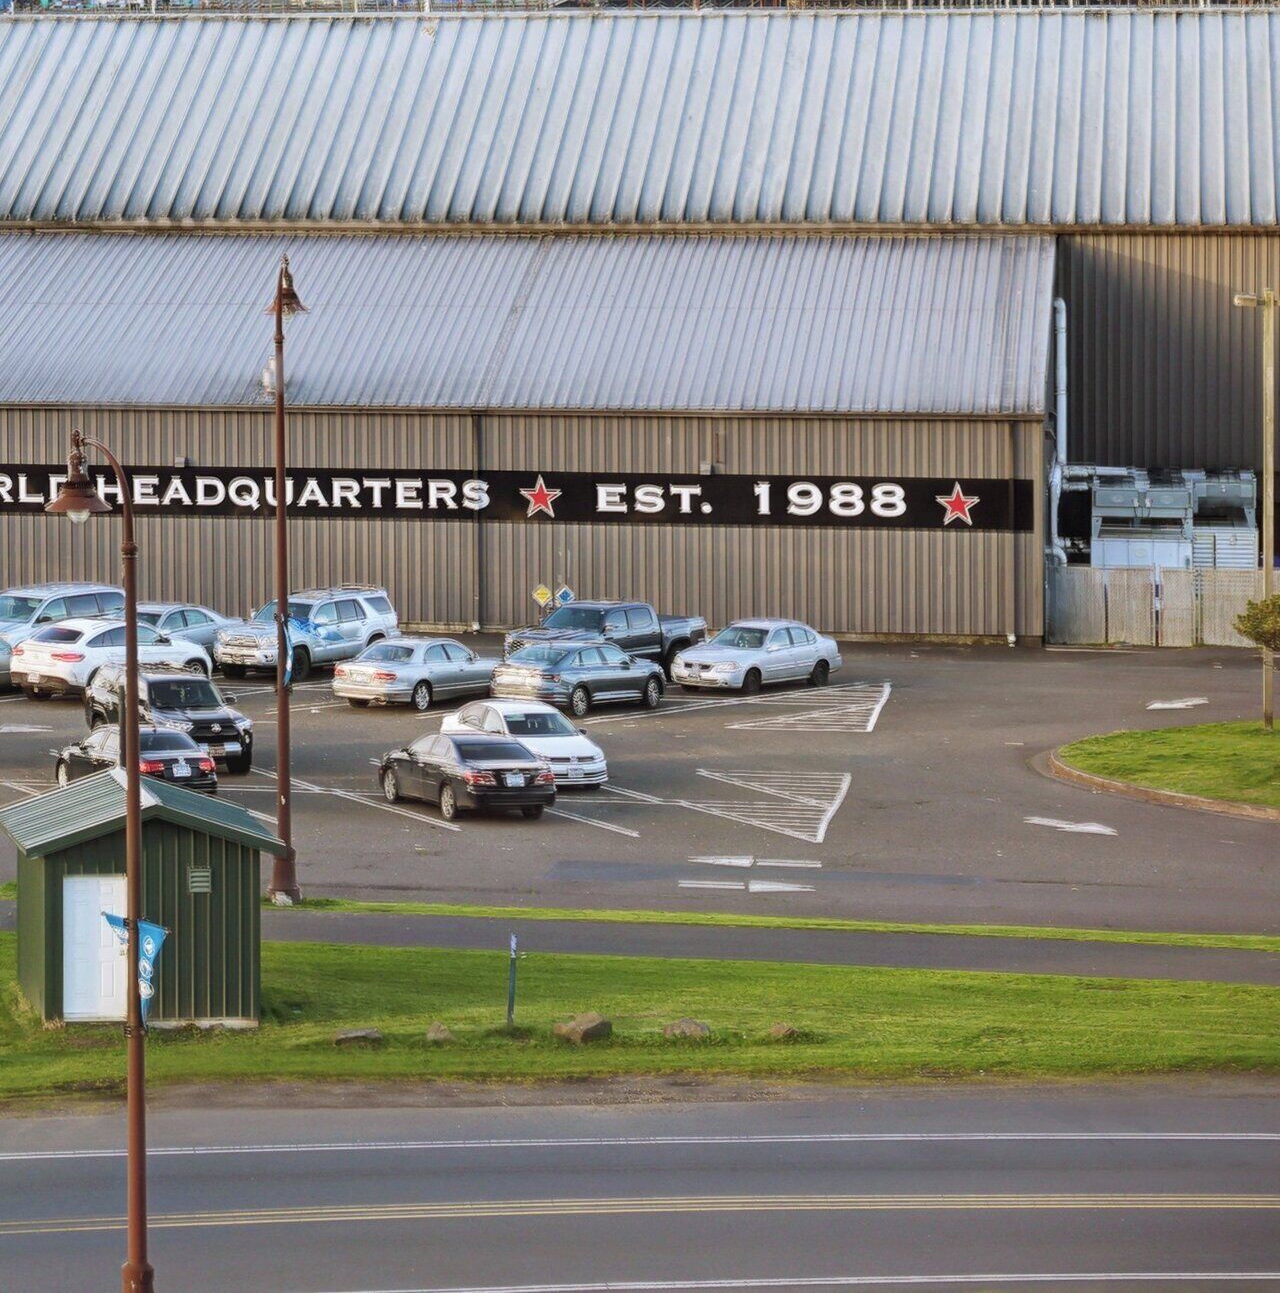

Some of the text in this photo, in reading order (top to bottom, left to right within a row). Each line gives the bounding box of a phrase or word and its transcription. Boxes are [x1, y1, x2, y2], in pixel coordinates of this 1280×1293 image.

[95, 474, 491, 511] HEADQUARTERS
[595, 482, 713, 514] EST.
[753, 481, 908, 517] 1988
